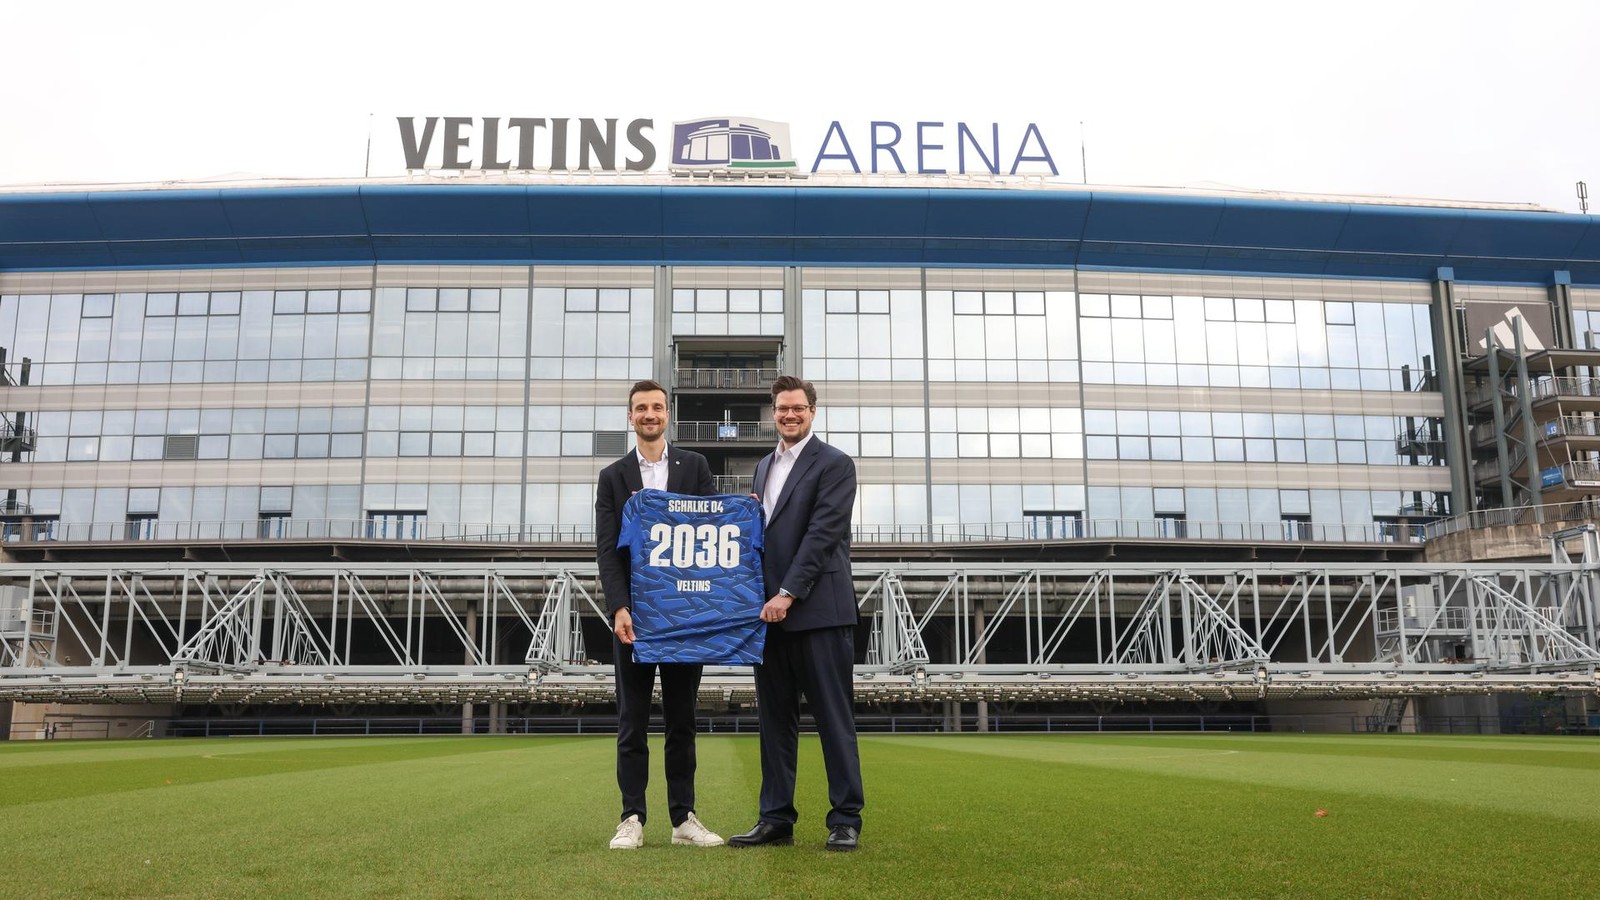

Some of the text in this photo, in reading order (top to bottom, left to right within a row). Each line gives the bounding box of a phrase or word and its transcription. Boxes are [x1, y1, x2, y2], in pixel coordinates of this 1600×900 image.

[397, 116, 1060, 175] VELTINS ARENA
[668, 500, 724, 513] SCHALKE 04
[649, 523, 741, 569] 2036
[677, 580, 711, 592] VELTINS
